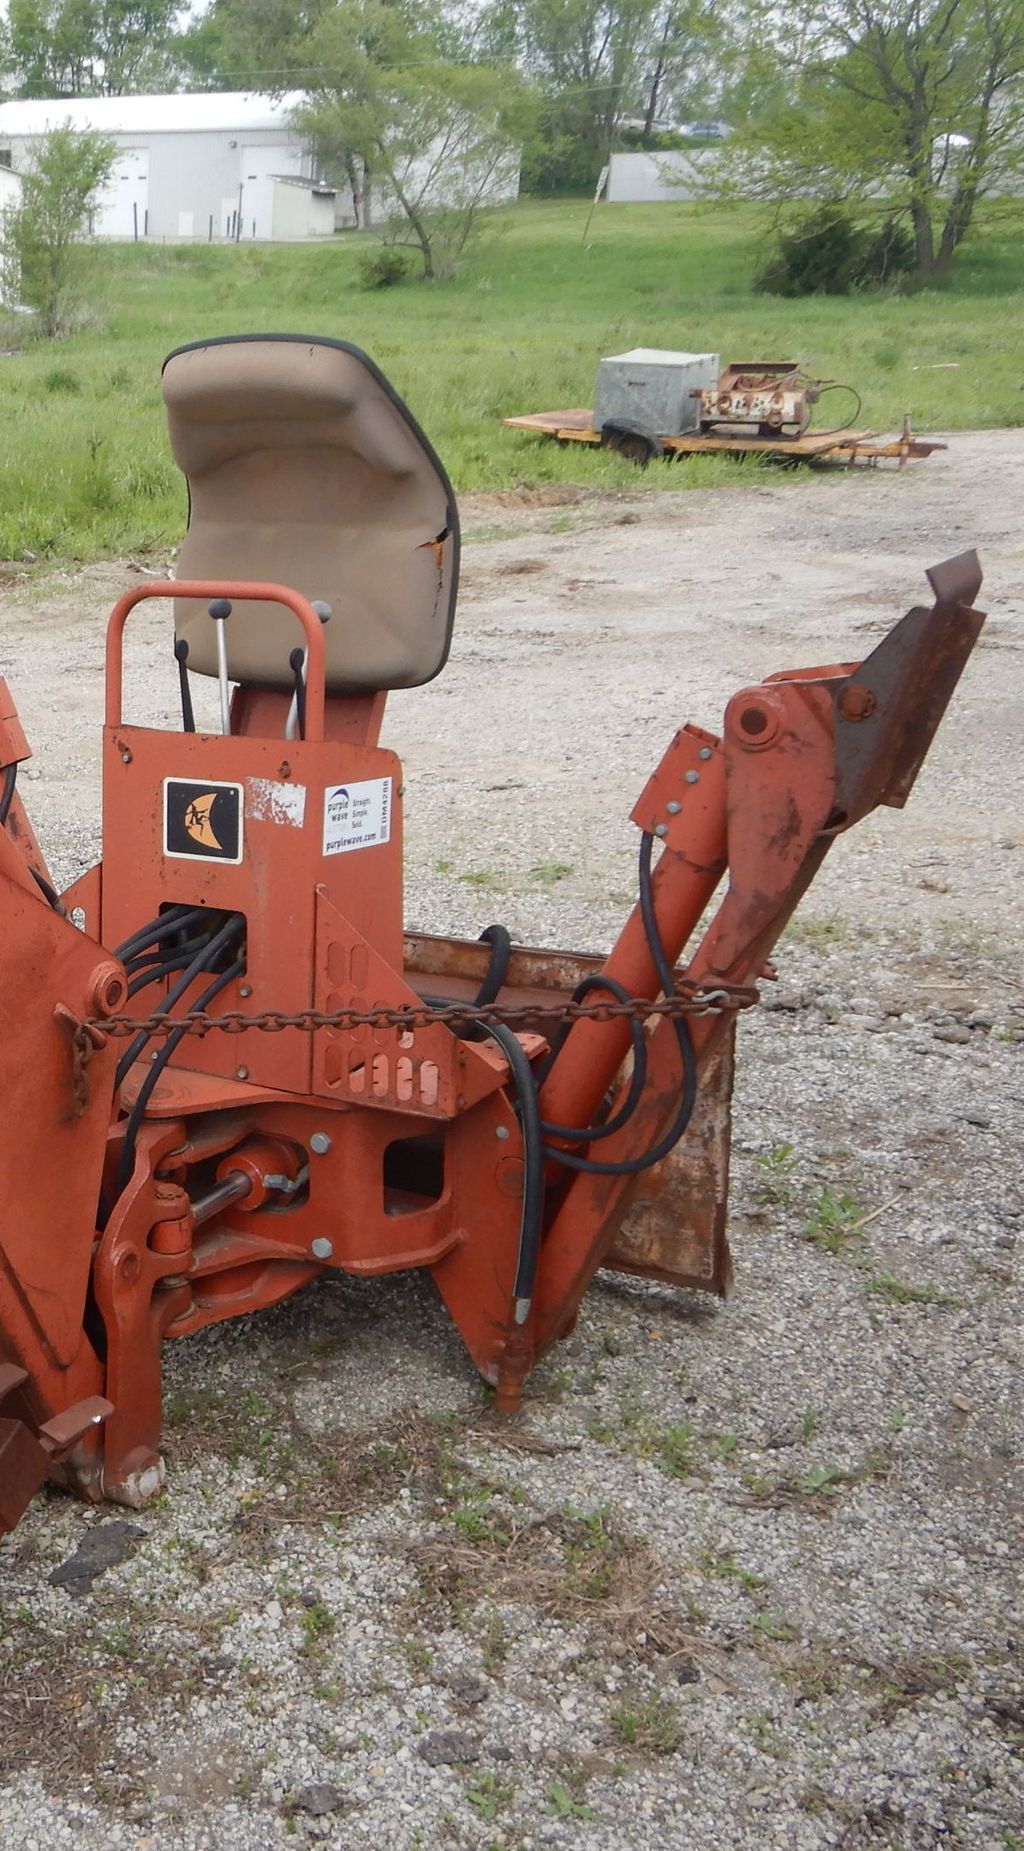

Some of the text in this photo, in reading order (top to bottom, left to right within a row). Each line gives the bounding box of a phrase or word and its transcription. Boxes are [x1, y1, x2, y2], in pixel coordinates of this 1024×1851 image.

[327, 798, 349, 814] purple
[331, 812, 348, 822] wave
[326, 833, 377, 853] purplewave.com
